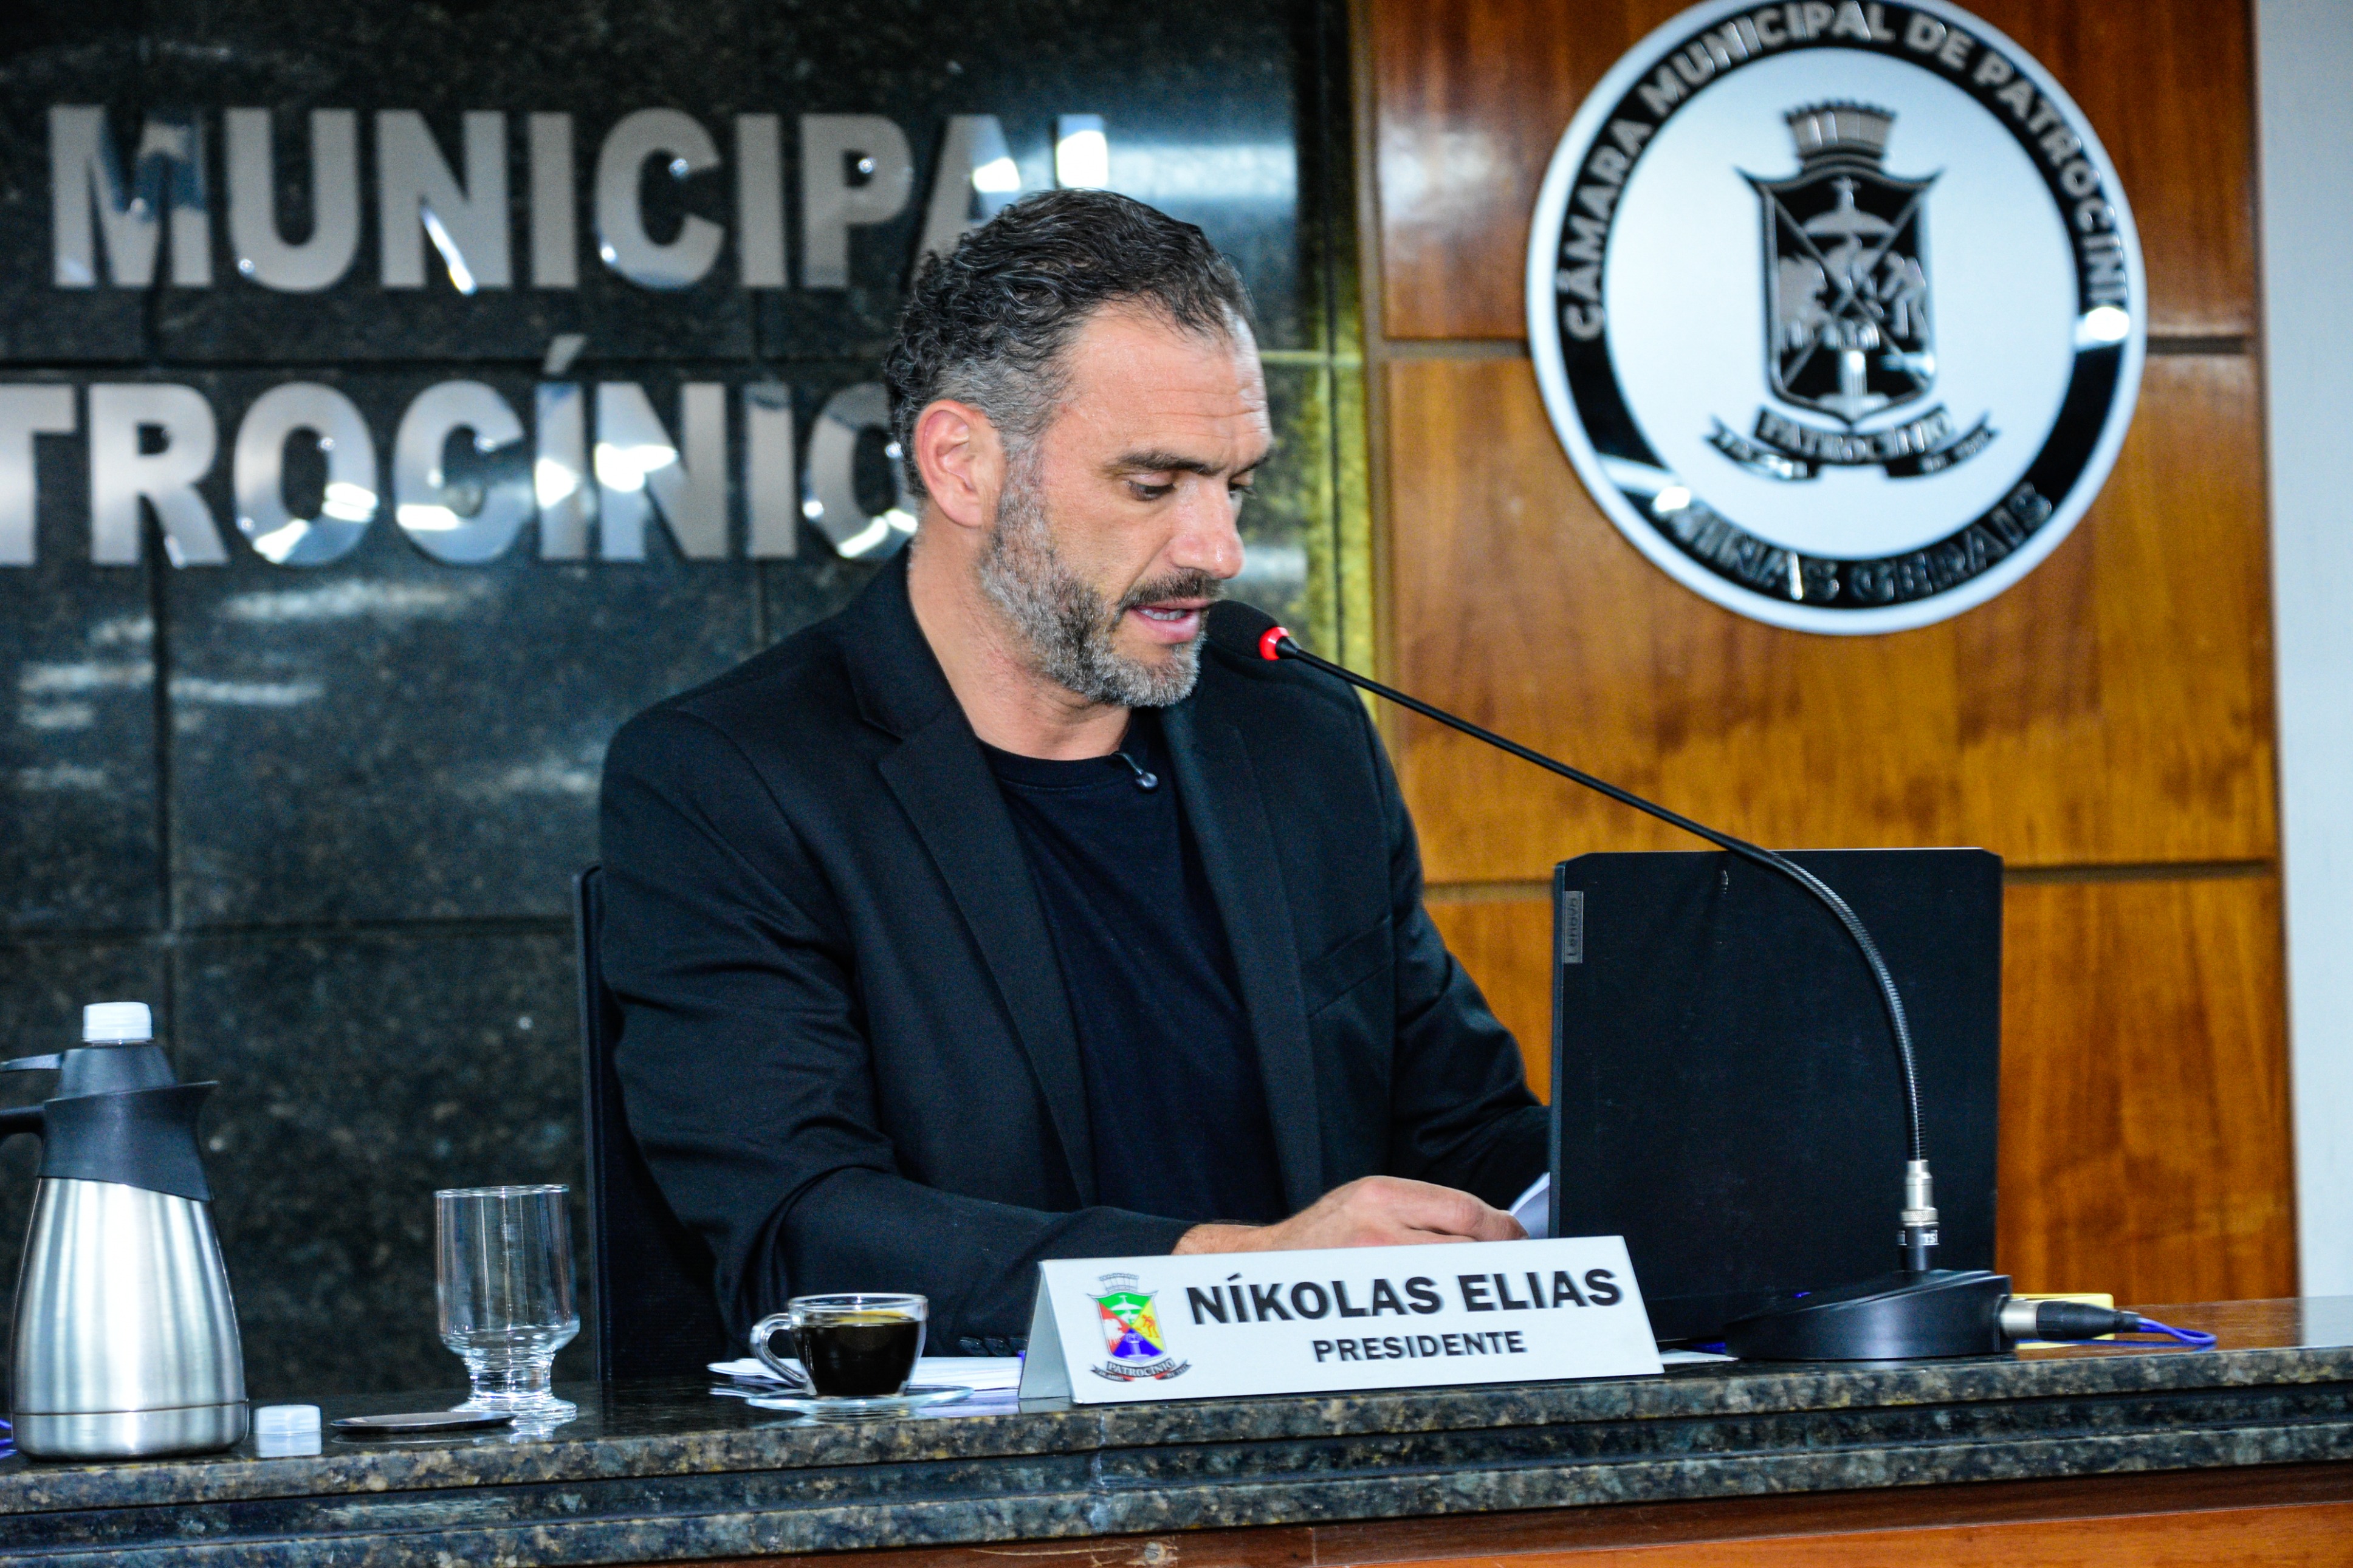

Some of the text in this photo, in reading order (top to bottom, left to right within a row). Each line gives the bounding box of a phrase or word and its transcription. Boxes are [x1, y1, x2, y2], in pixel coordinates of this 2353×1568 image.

[1556, 118, 1654, 341] CÂMARA
[1637, 0, 1897, 118] MUNICIPAL
[1904, 12, 1976, 70] DE
[1849, 481, 2052, 601] GERAIS
[1186, 1268, 1624, 1324] NÍKOLAS ELIAS
[1313, 1330, 1528, 1363] PRESIDENTE
